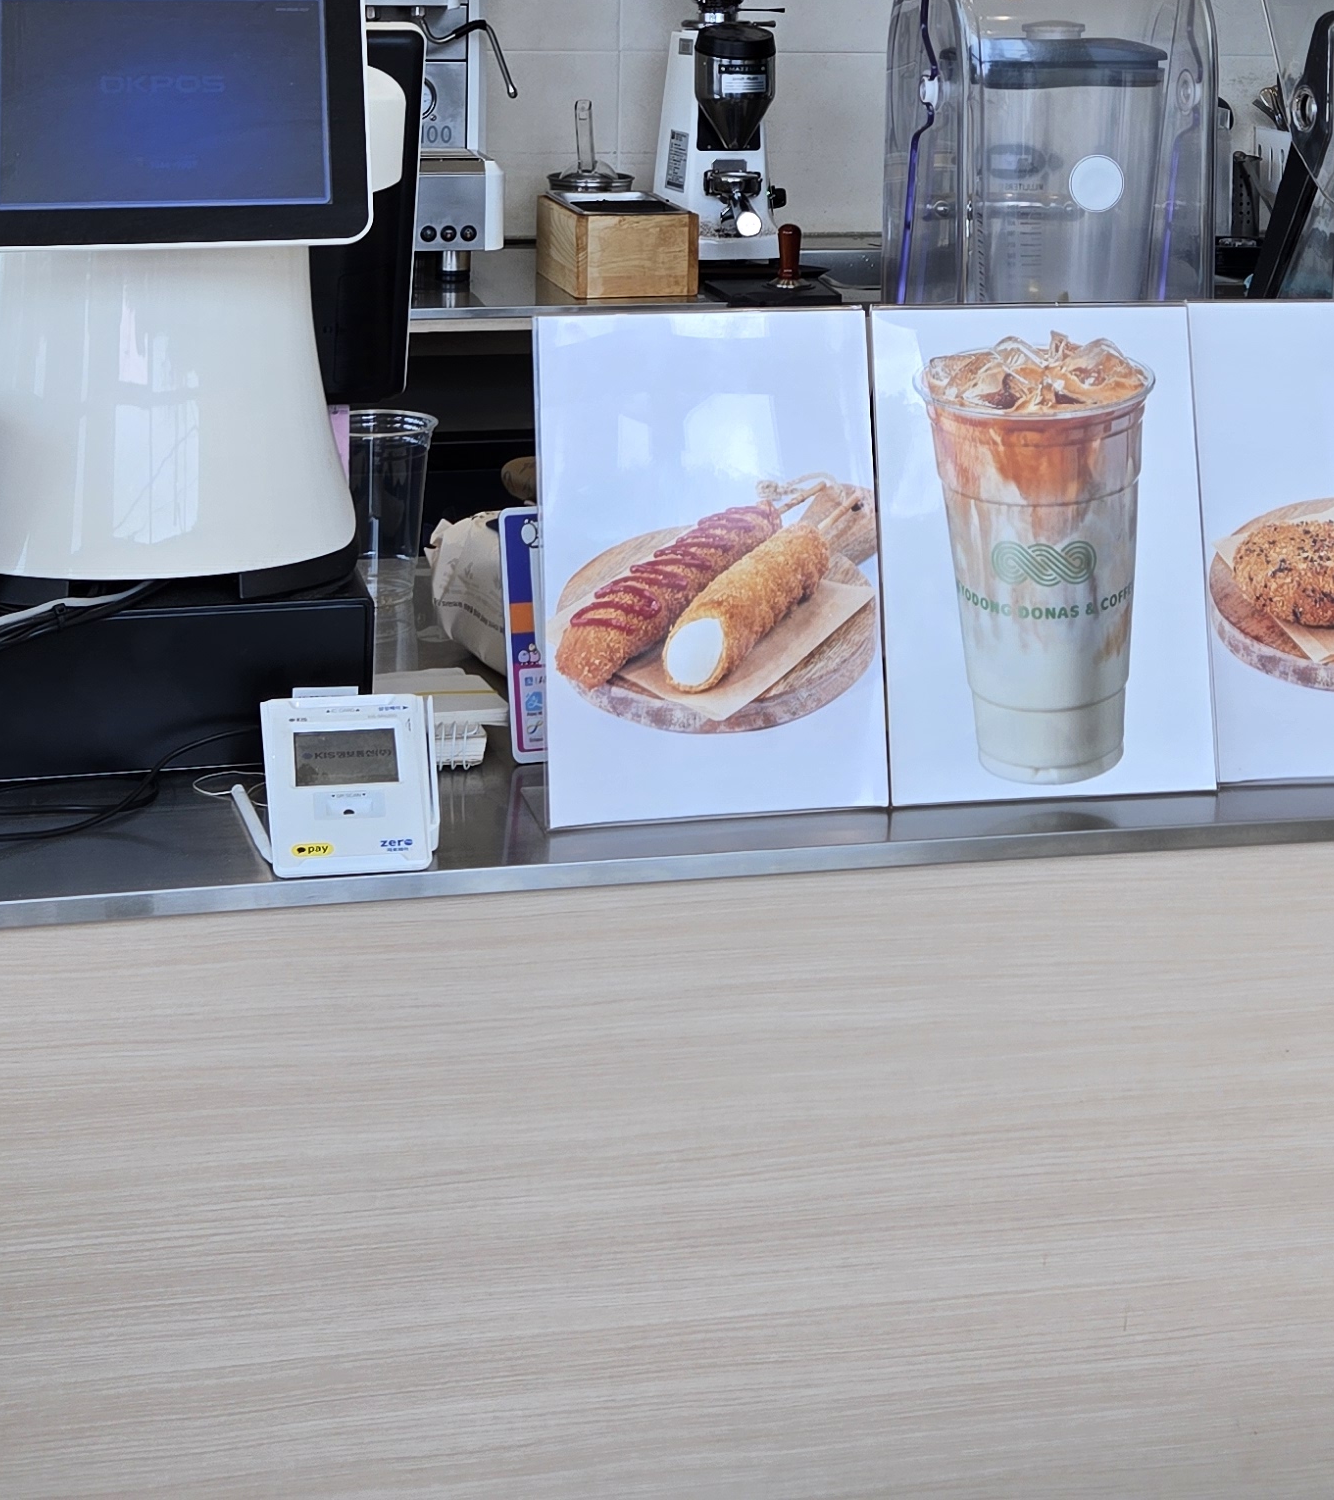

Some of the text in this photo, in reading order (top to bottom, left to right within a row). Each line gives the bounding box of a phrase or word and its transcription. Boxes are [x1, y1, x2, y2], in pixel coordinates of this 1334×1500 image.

[1018, 605, 1079, 620] DONAS
[1085, 604, 1096, 615] &
[308, 845, 329, 854] pay
